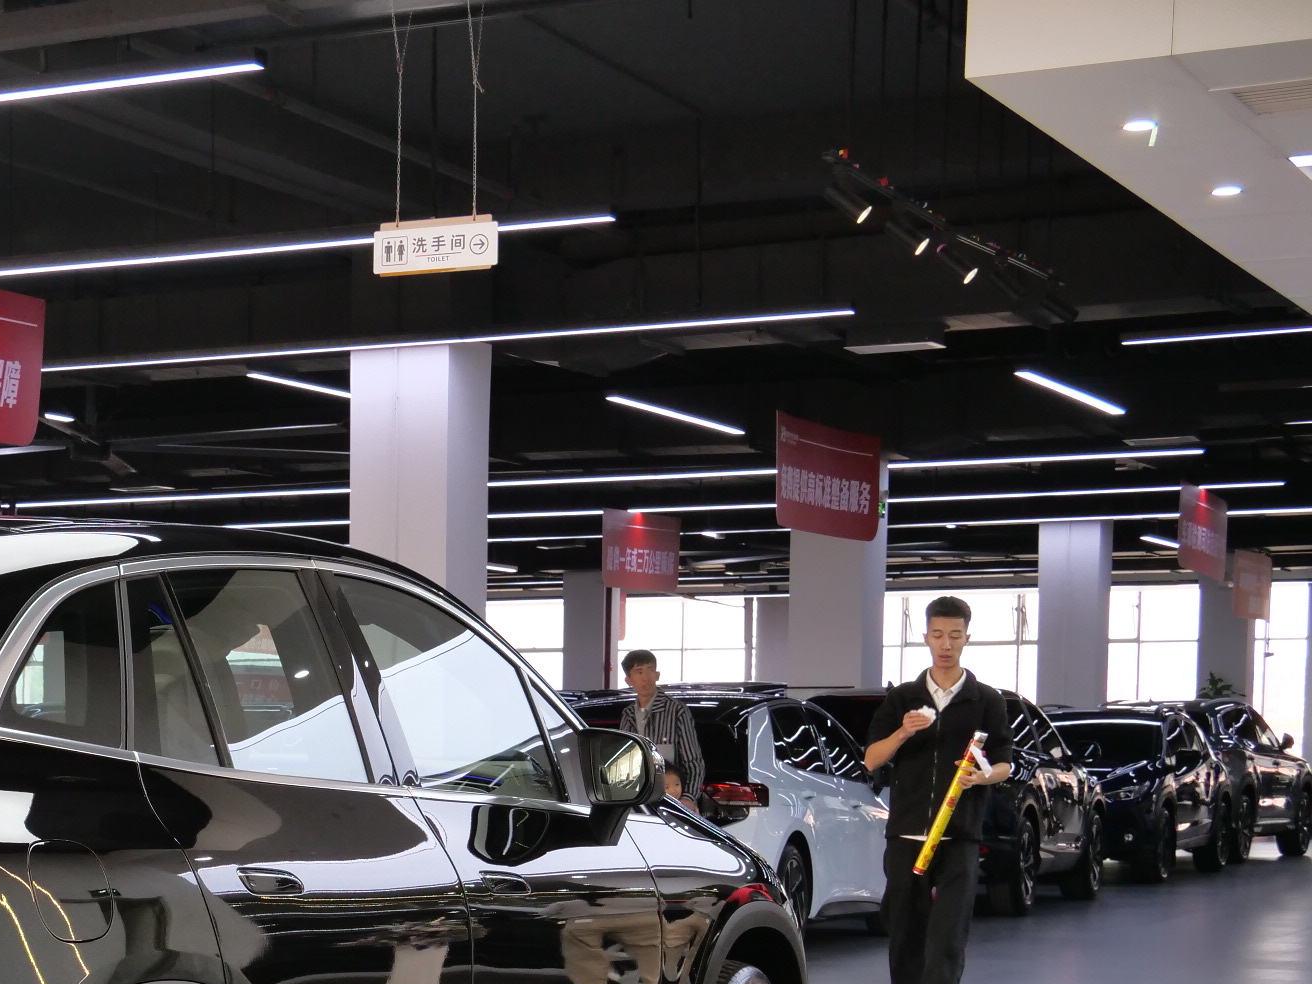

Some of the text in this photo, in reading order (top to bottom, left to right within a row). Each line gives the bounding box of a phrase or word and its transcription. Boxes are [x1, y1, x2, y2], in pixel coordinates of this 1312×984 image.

[412, 234, 466, 253] 洗手间
[427, 255, 450, 263] TOILET
